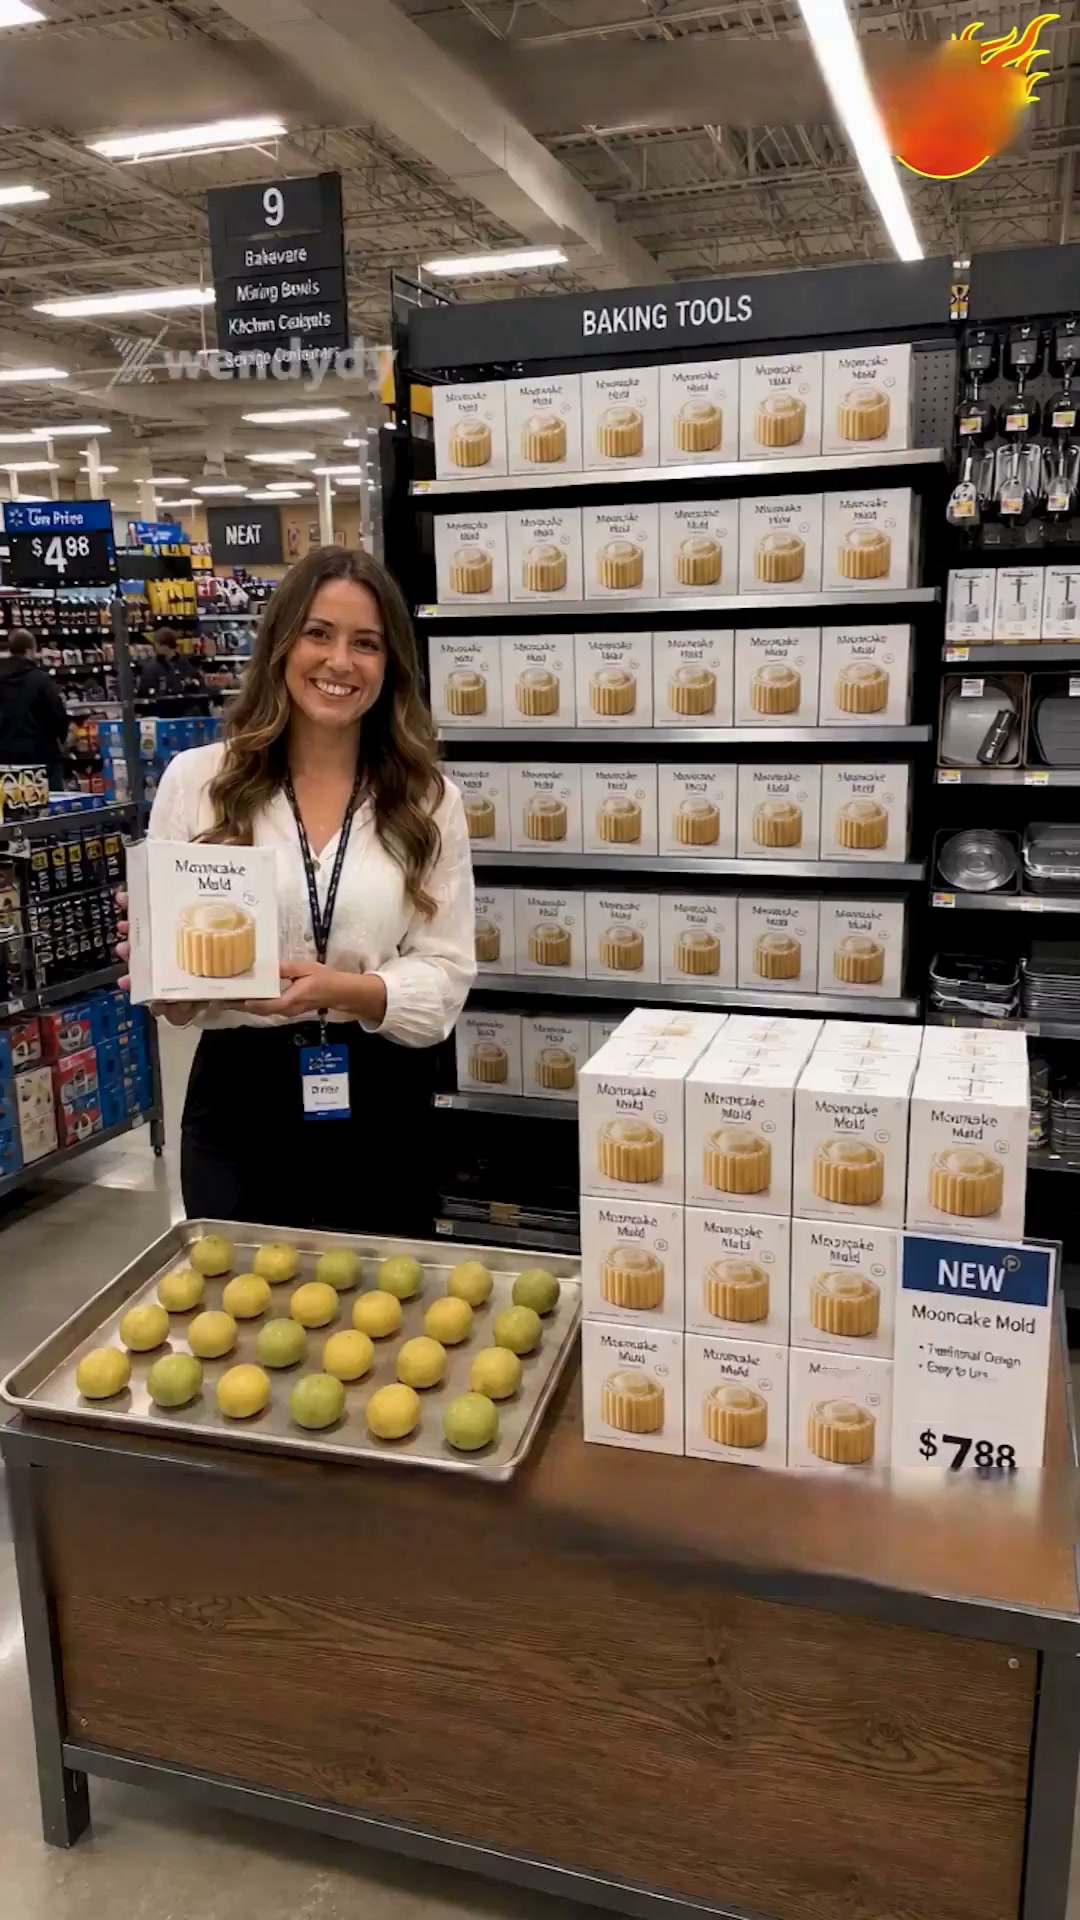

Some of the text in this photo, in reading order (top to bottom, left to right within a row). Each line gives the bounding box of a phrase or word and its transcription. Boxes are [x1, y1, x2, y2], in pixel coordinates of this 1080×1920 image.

[262, 187, 284, 226] 9
[583, 295, 752, 336] BAKING TOOLS
[225, 523, 262, 545] NEAT
[938, 1259, 1006, 1293] NEW
[912, 1304, 1036, 1335] Mooncake Mold
